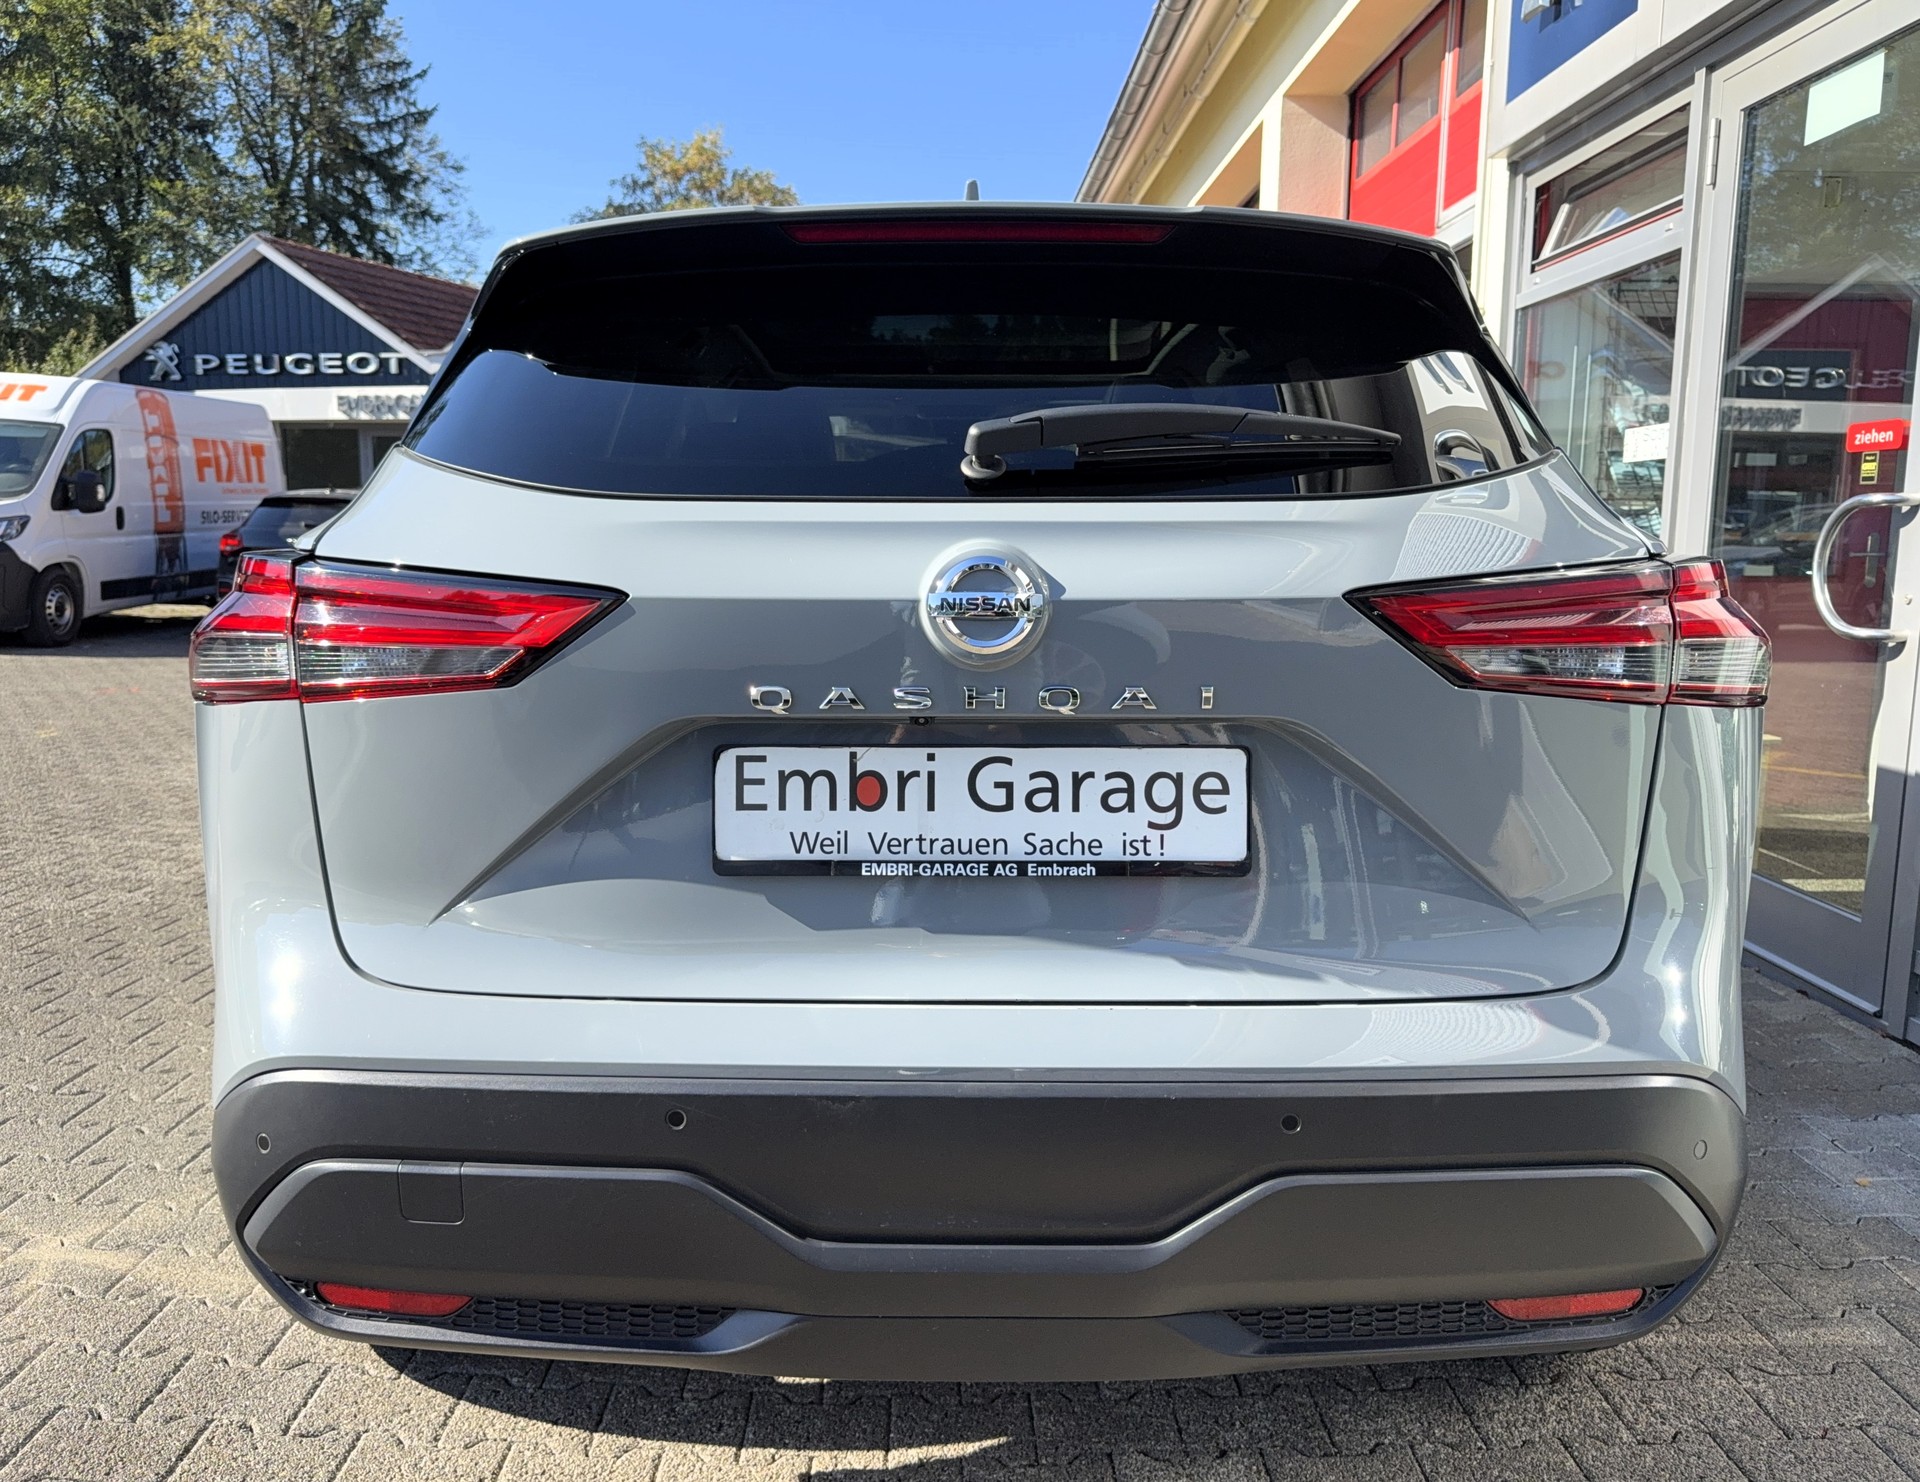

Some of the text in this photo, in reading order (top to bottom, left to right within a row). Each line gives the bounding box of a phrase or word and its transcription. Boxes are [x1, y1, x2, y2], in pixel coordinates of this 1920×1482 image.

[194, 351, 408, 376] PEUGEOT
[1854, 427, 1894, 446] ziehen
[192, 438, 266, 484] FIXIT
[940, 597, 1031, 613] NISSAN
[750, 685, 1214, 714] QASHQAI
[735, 751, 1231, 831] Embri Garage
[789, 830, 848, 855] Weil
[867, 832, 1009, 856] Vertrauen
[1023, 831, 1103, 856] Sache
[861, 863, 1096, 877] EMBRI-GARAGE AG Embrach
